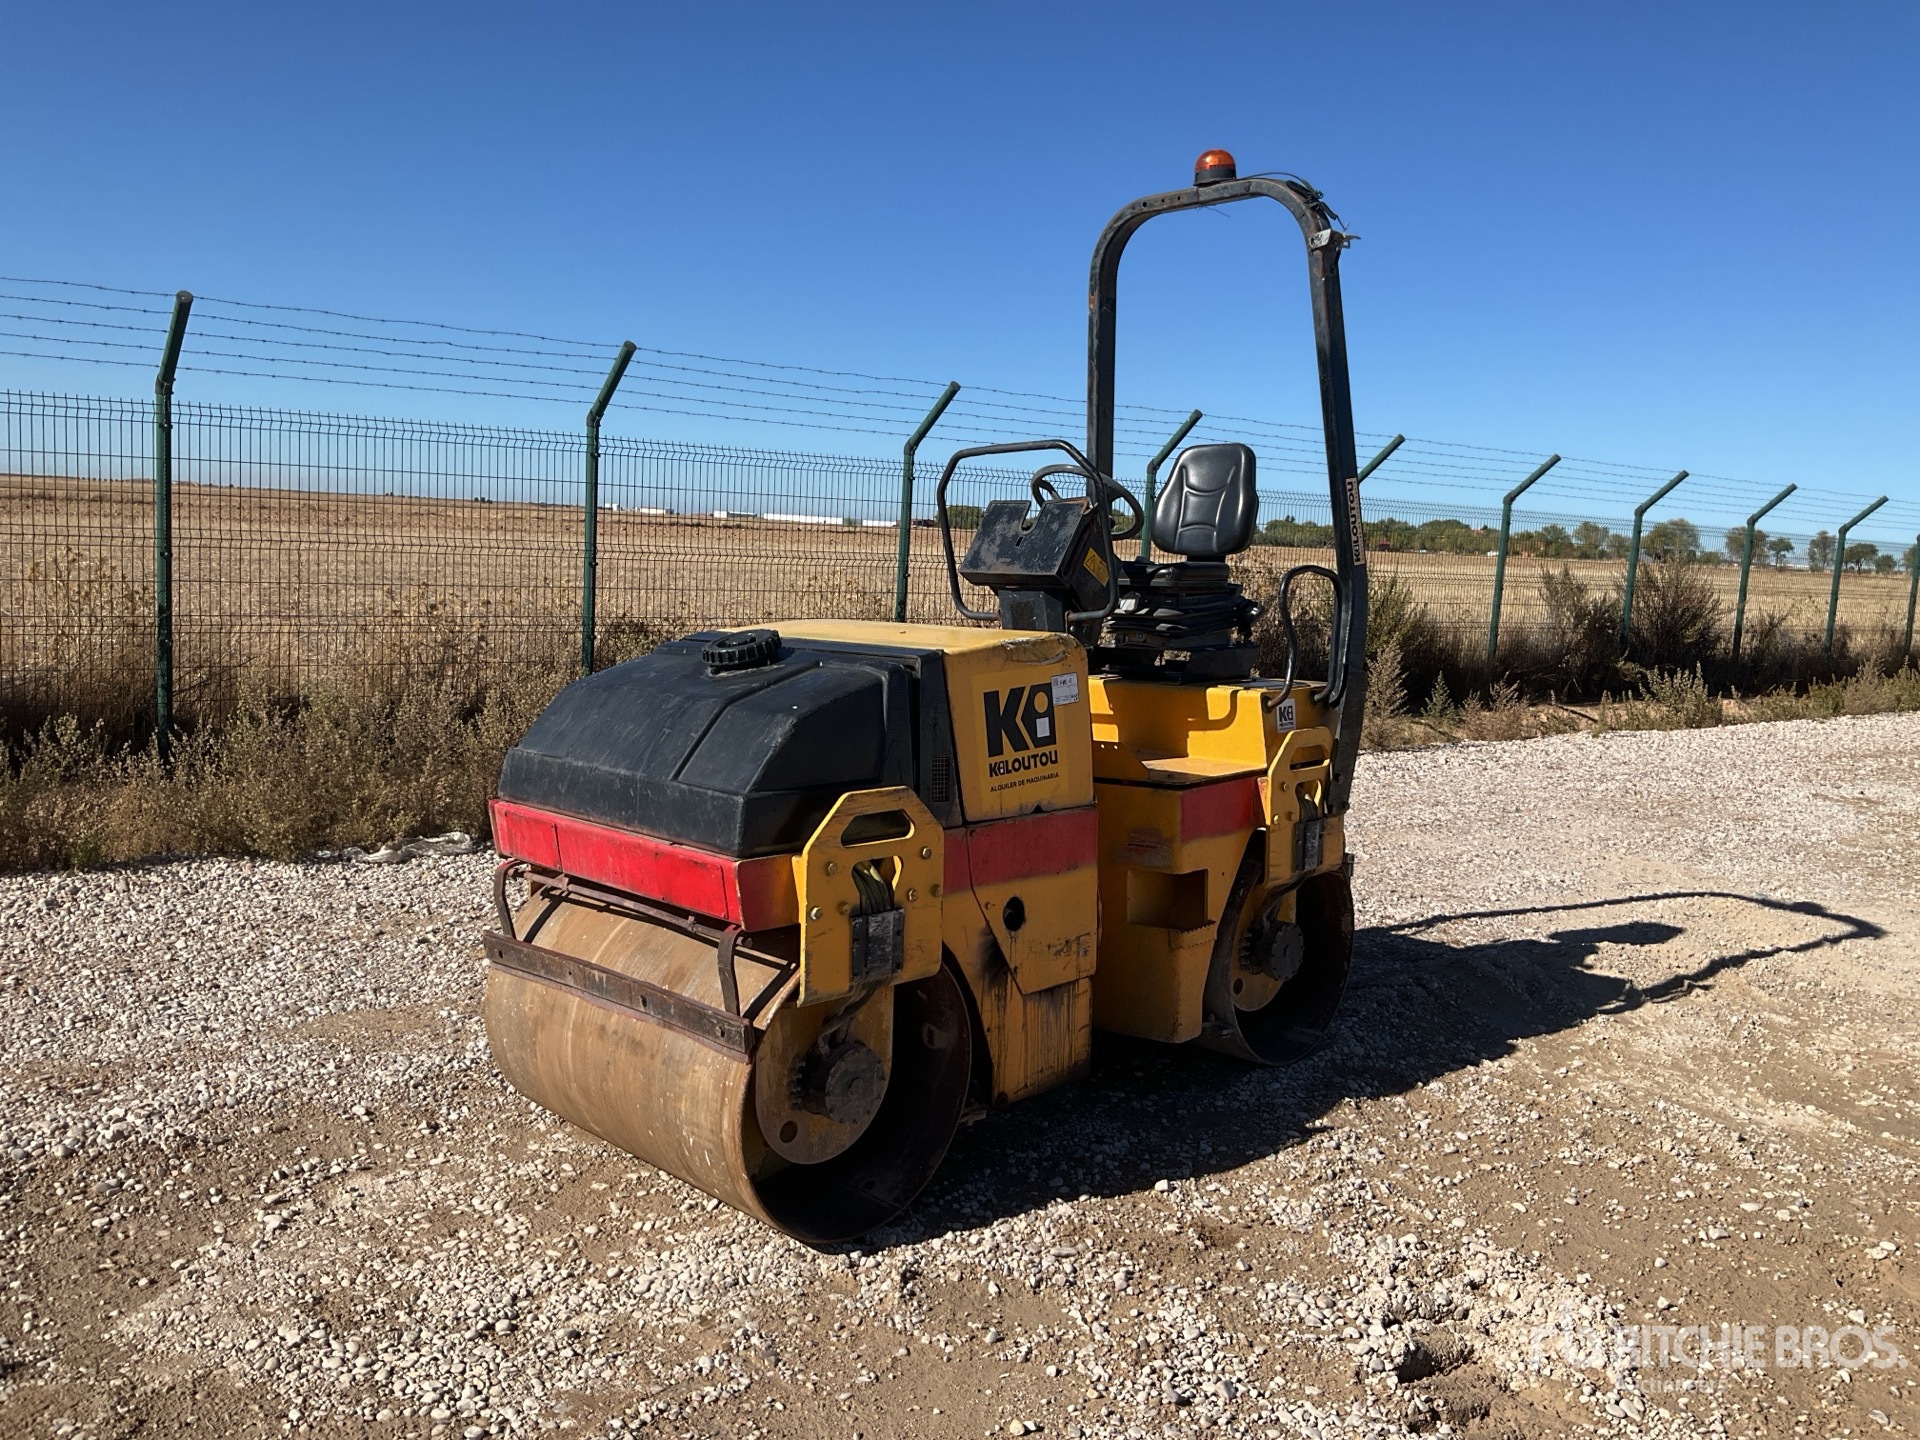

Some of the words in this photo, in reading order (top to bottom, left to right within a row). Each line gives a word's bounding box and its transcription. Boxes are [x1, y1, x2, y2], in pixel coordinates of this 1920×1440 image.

[990, 781, 1017, 792] ALQUILER
[1018, 775, 1026, 786] DE
[1026, 772, 1059, 785] MAQUINARIA
